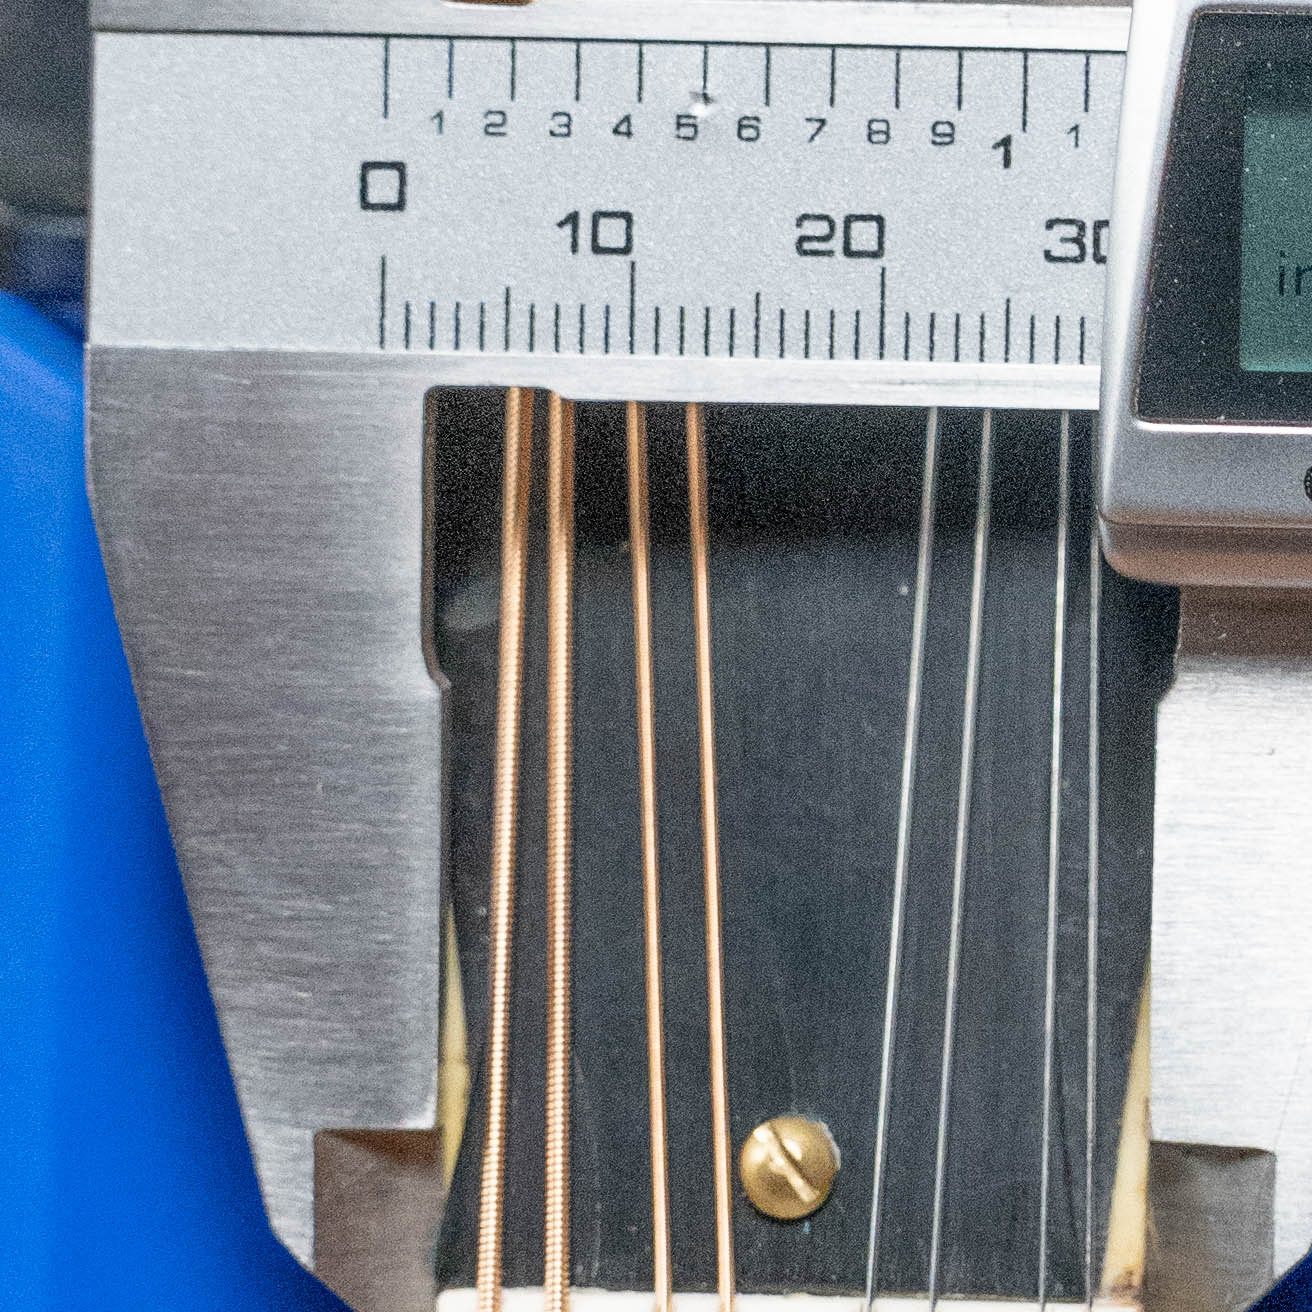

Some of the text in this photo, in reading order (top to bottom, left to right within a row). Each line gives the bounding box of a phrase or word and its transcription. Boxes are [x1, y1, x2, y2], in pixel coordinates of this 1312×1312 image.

[430, 109, 1082, 169] 1 2 3 4 5 6 7 8 9 1 1
[360, 160, 406, 211] 0
[556, 210, 633, 256] 10
[795, 213, 886, 259] 20
